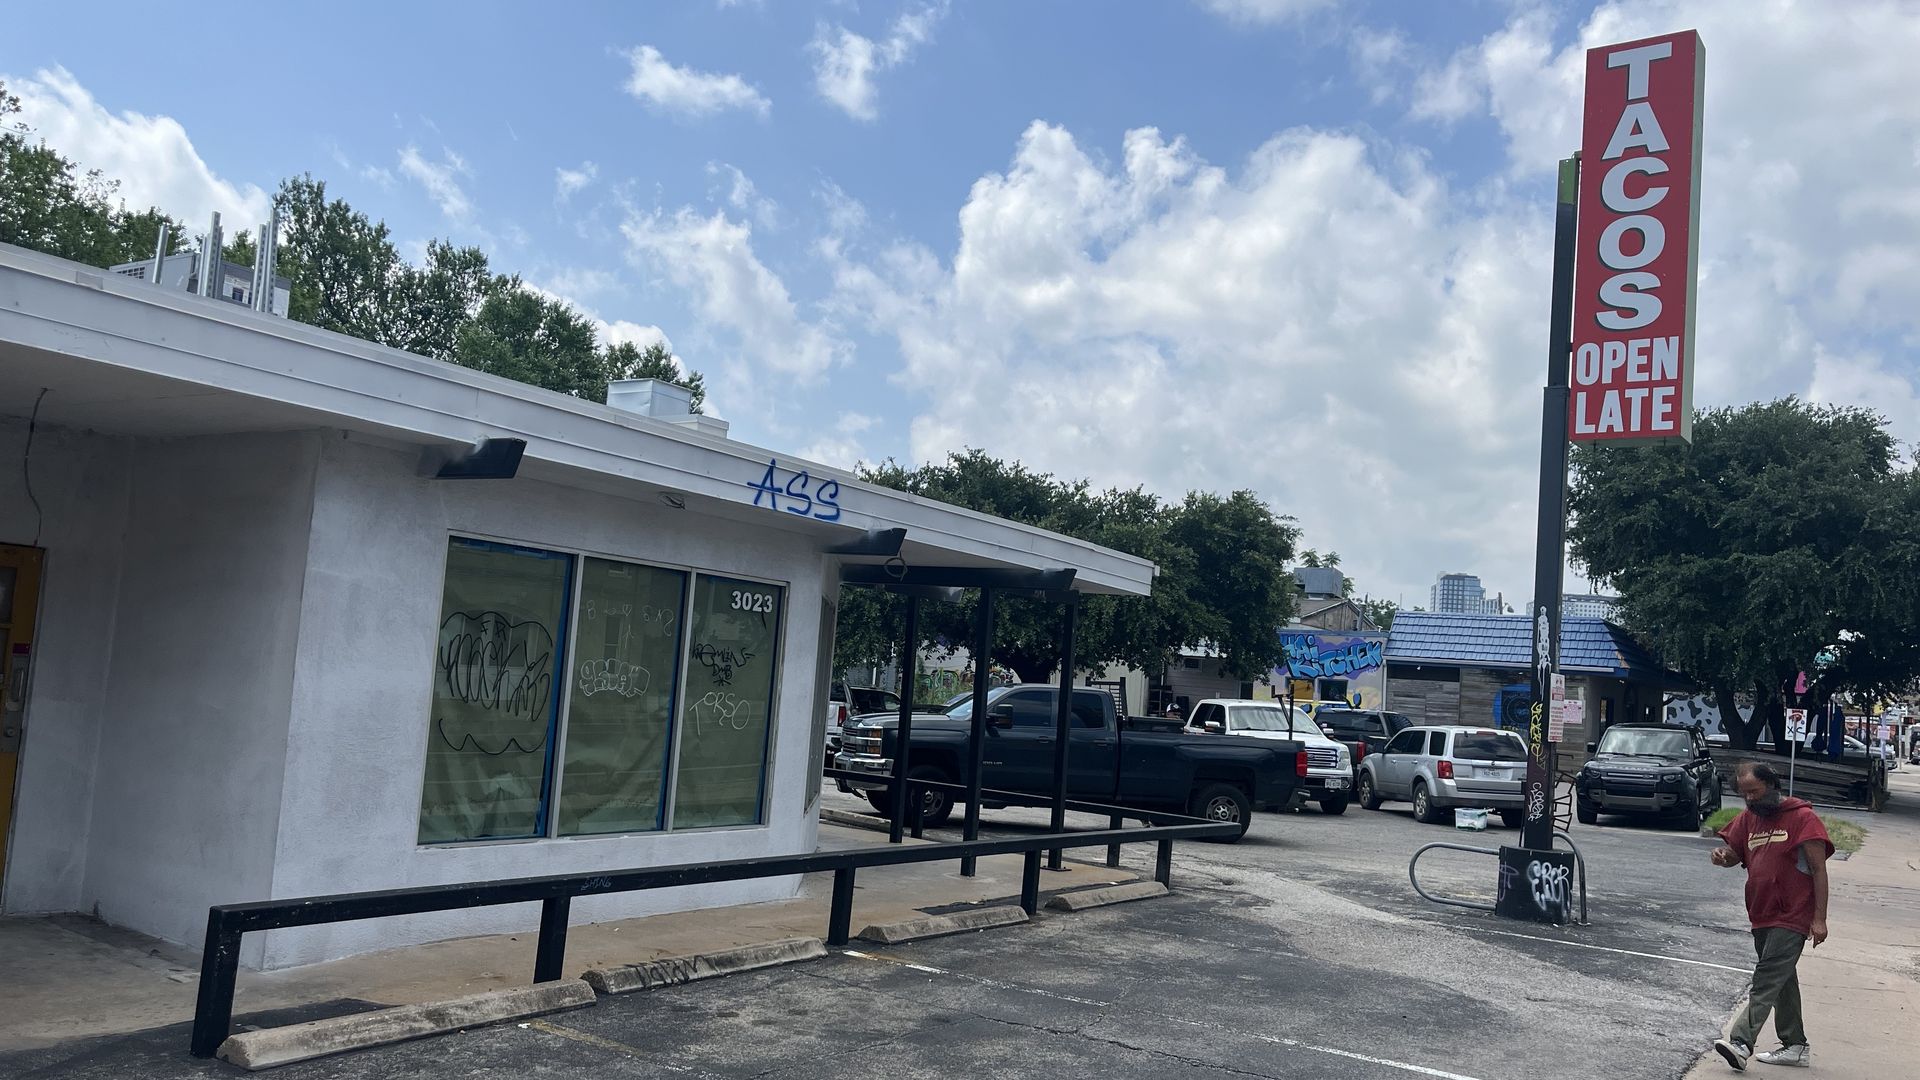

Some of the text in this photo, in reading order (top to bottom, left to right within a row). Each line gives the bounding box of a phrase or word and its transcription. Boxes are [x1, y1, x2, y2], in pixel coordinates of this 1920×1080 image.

[1596, 41, 1673, 330] TACOS
[1576, 336, 1680, 386] OPEN
[1575, 386, 1676, 434] LATE
[747, 458, 840, 521] ASS
[731, 590, 773, 613] 3023
